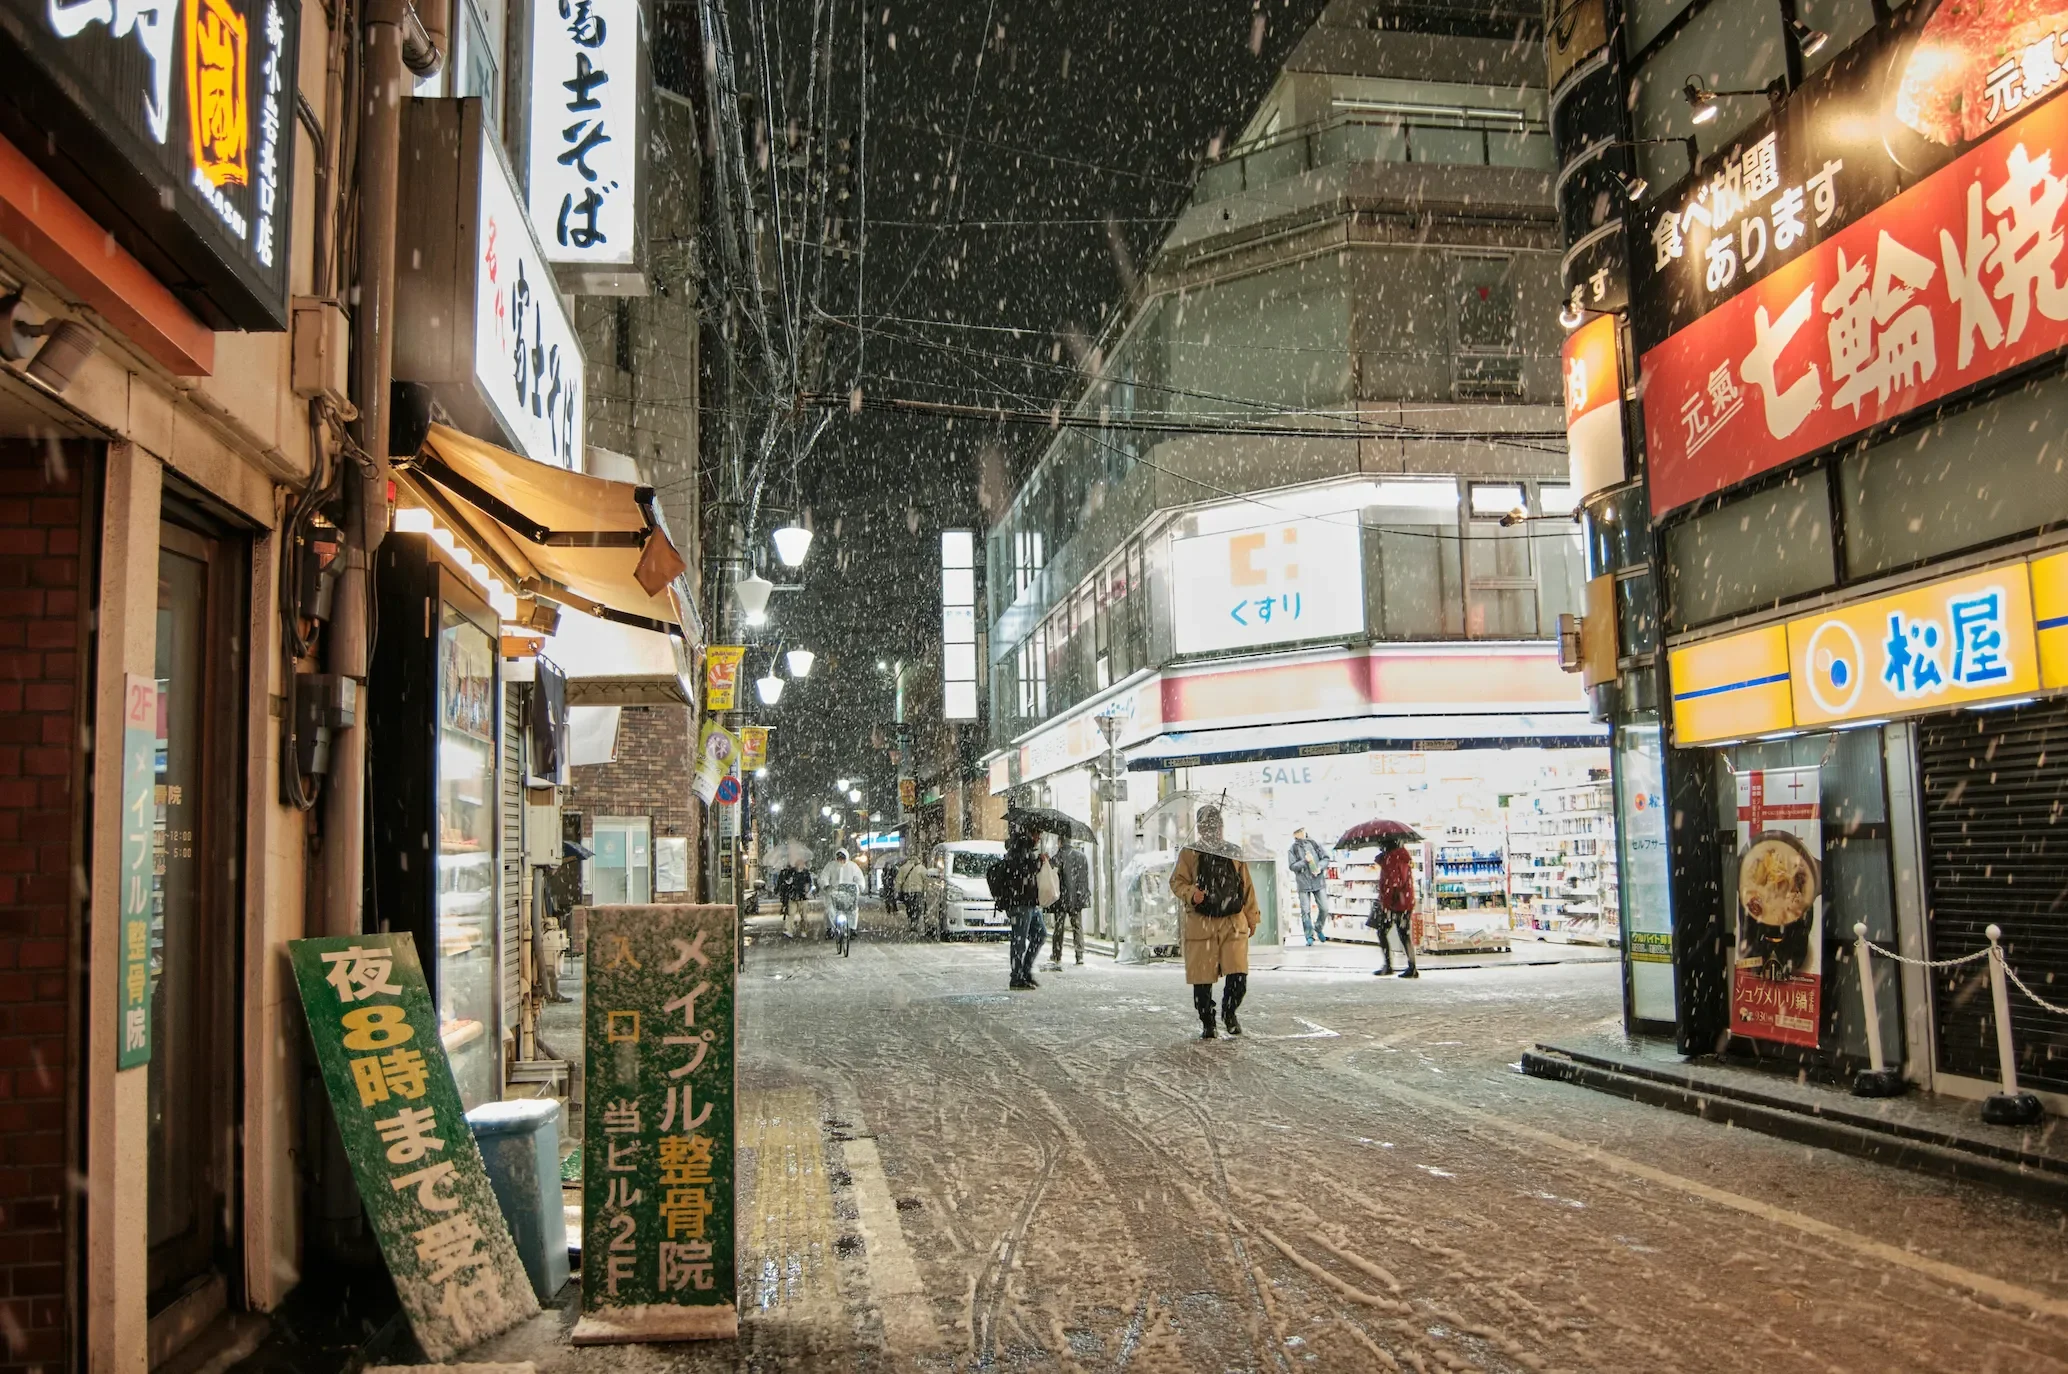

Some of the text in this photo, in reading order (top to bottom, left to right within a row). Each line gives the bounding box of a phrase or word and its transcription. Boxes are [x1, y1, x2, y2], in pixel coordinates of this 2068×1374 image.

[1983, 28, 2068, 124] 元氣
[193, 168, 247, 240] ARASHI
[1650, 131, 1781, 273] 食べ放題
[1704, 158, 1845, 293] あります
[512, 257, 578, 470] 富士そば
[1680, 358, 1741, 447] 元氣
[1230, 591, 1301, 626] くすり
[1882, 591, 2009, 694] 松屋
[131, 685, 154, 722] 2F
[1262, 766, 1312, 784] SALE
[125, 745, 150, 1052] メイプル整骨院
[606, 935, 641, 1043] 入口
[658, 930, 714, 1293] メイプル整骨院
[603, 1100, 641, 1295] 当ビル2F
